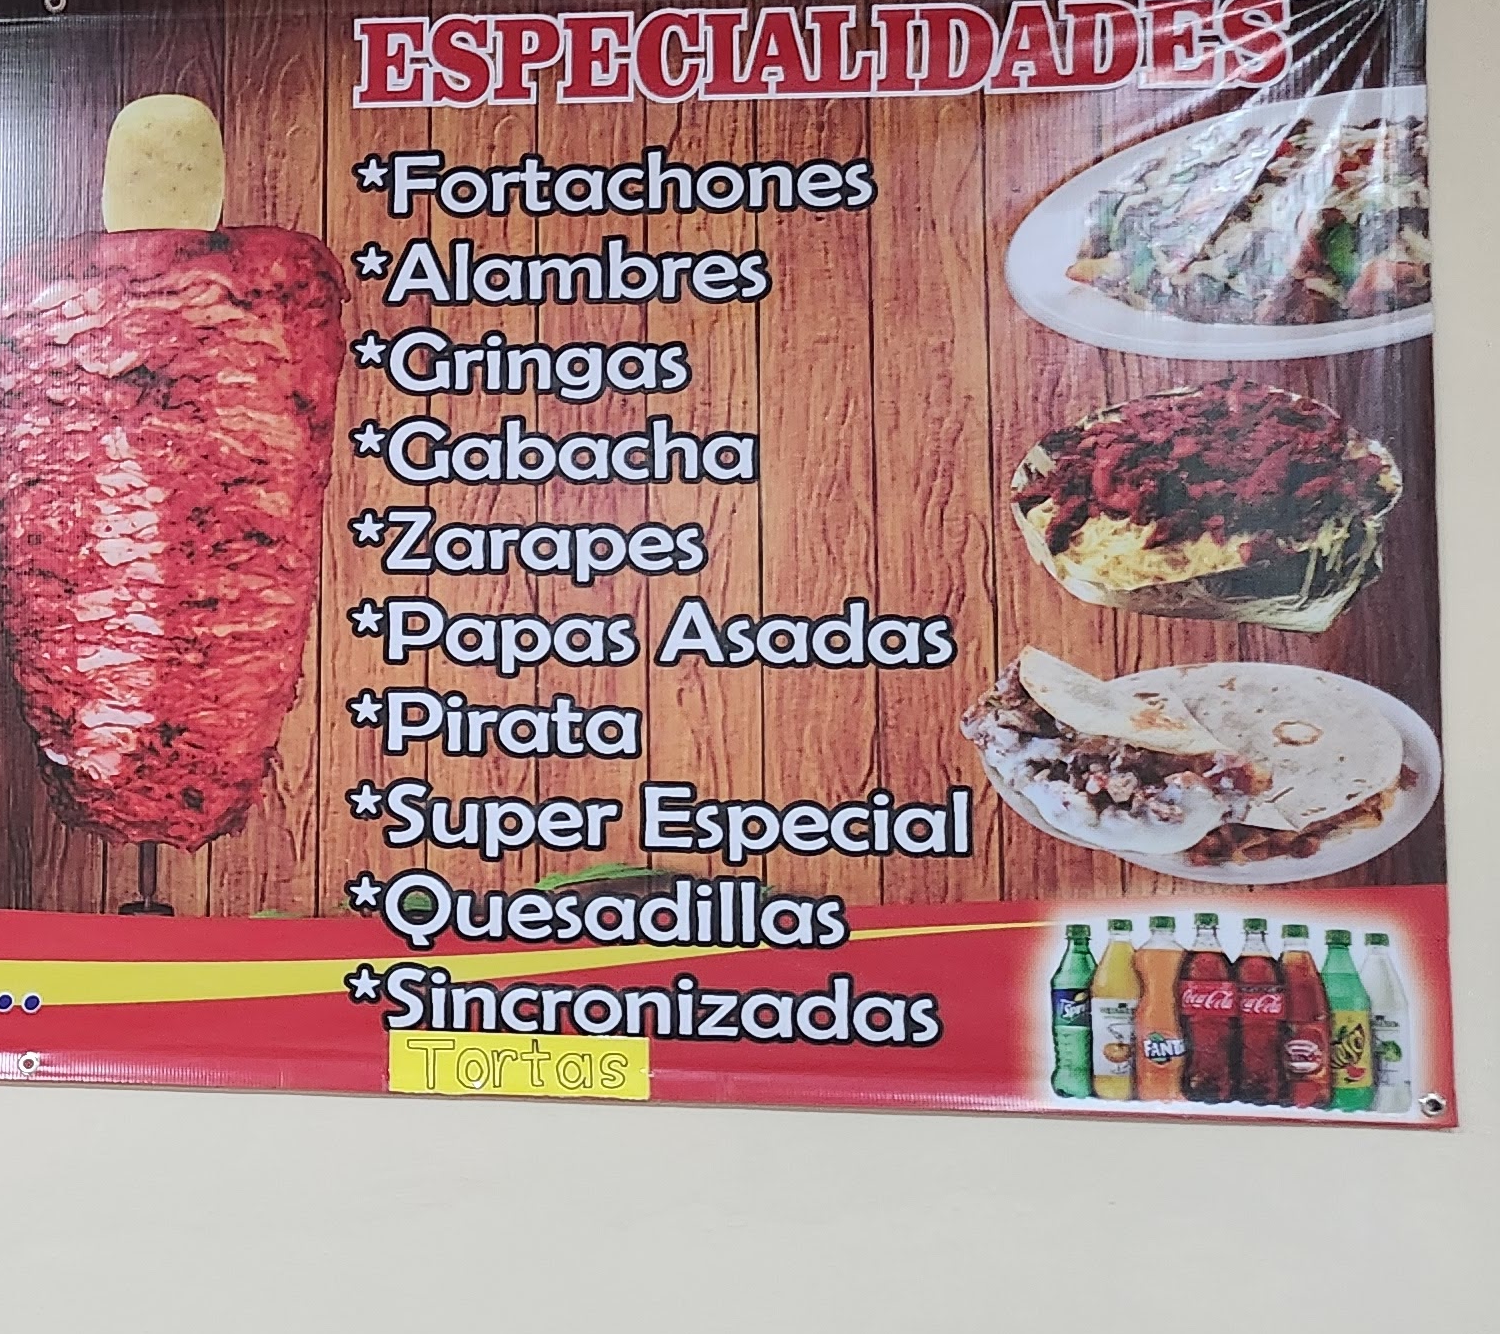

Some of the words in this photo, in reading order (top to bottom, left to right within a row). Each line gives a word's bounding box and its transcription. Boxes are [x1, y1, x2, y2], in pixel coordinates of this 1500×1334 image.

[656, 596, 956, 667] Asadas
[639, 782, 973, 865] Especial
[407, 1039, 628, 1090] Tortas
